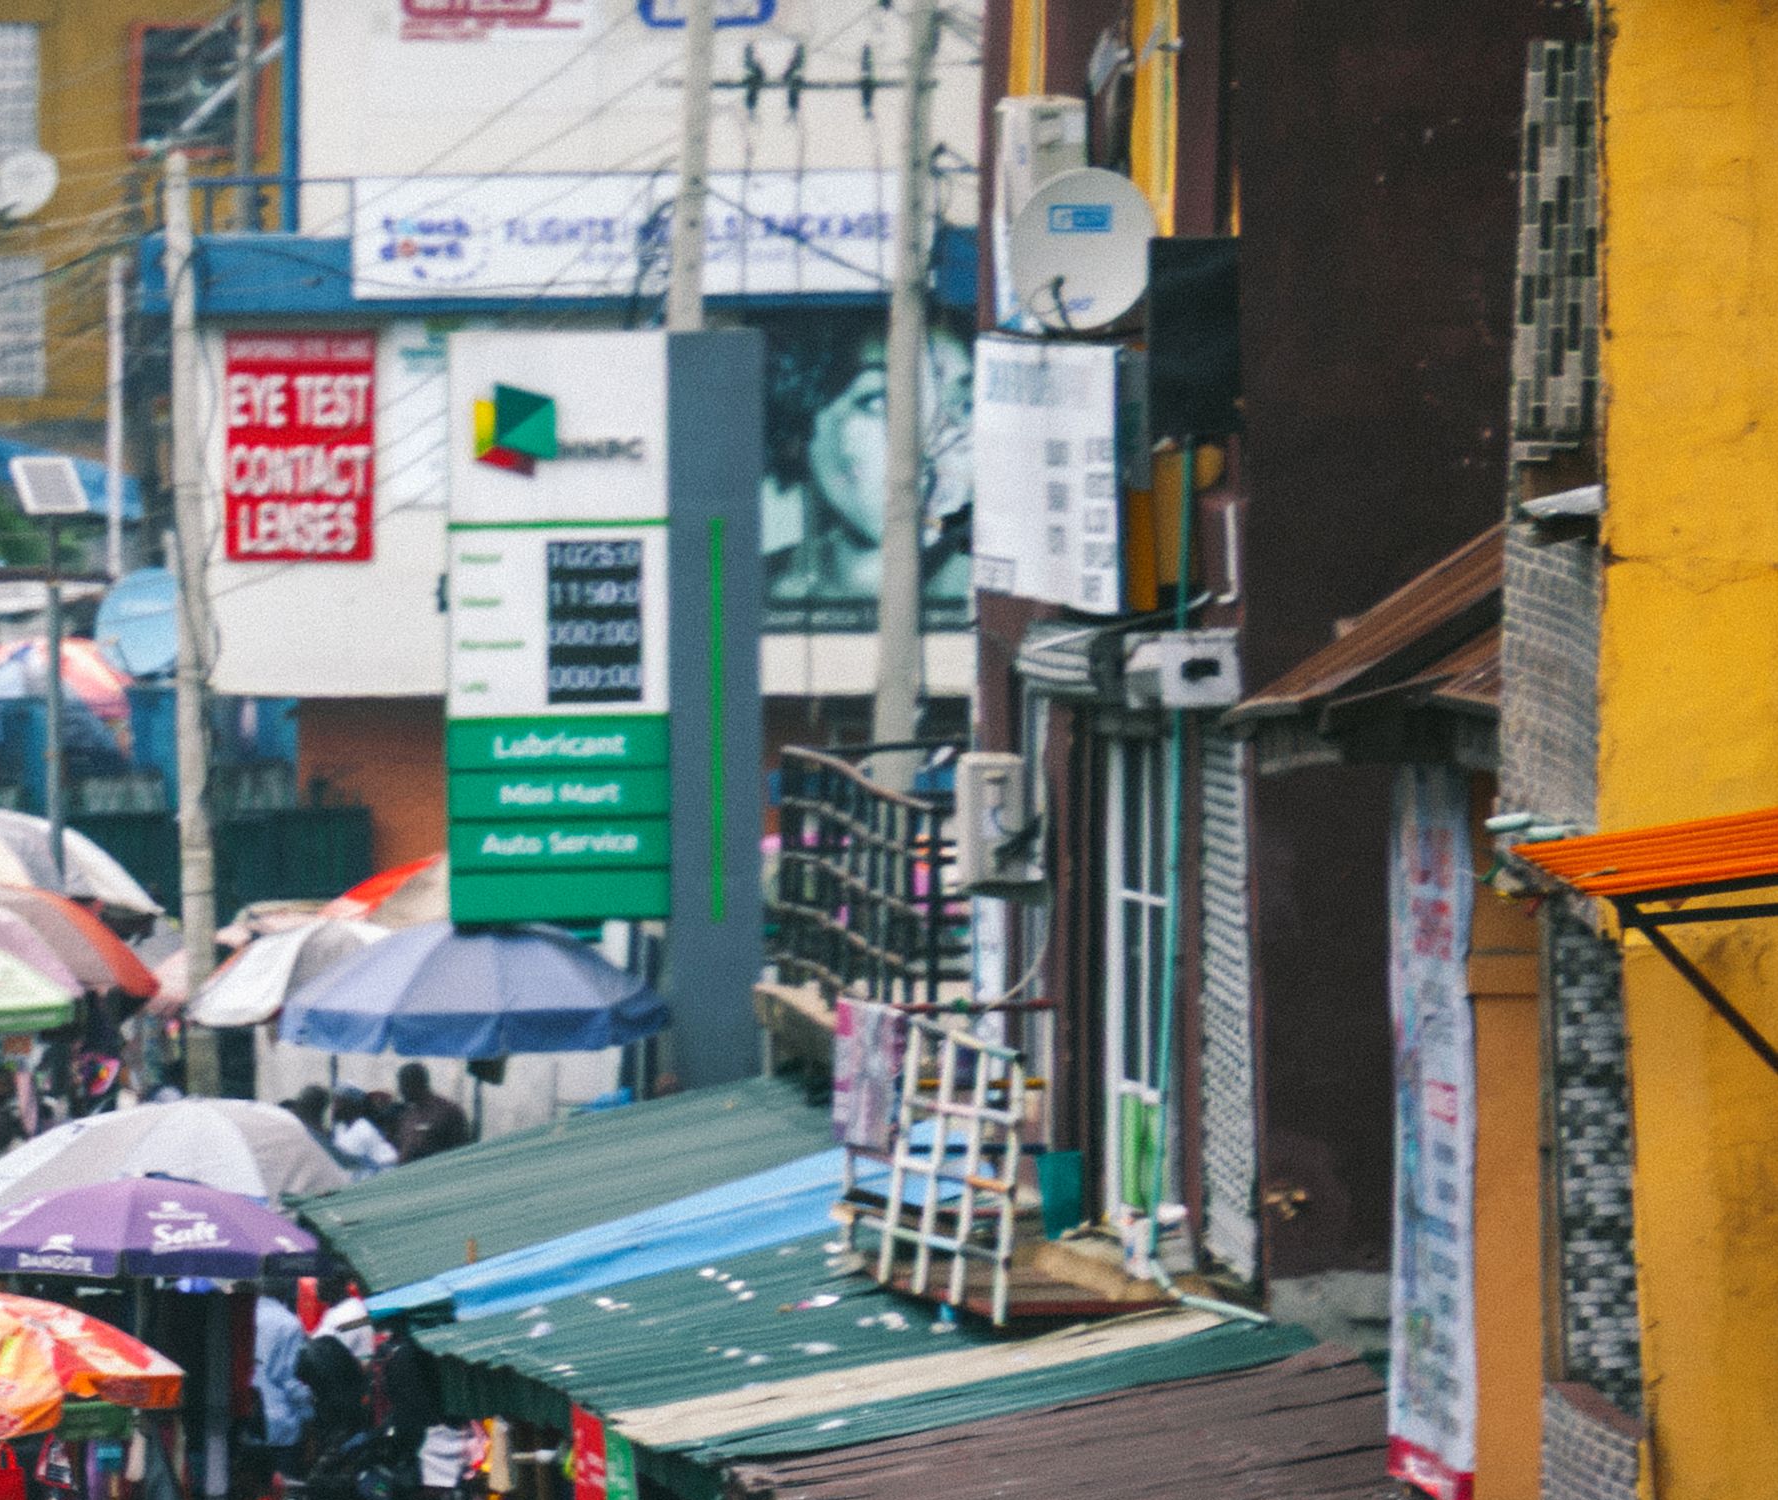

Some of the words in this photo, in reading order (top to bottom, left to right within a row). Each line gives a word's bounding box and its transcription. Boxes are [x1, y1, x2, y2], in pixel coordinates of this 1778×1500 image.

[228, 373, 288, 428] EYE
[294, 374, 371, 428] TEST
[229, 444, 372, 497] CONTACT
[237, 501, 357, 553] LENSES
[492, 731, 627, 759] Lubricant
[481, 832, 544, 856] Auto
[548, 829, 639, 855] Service
